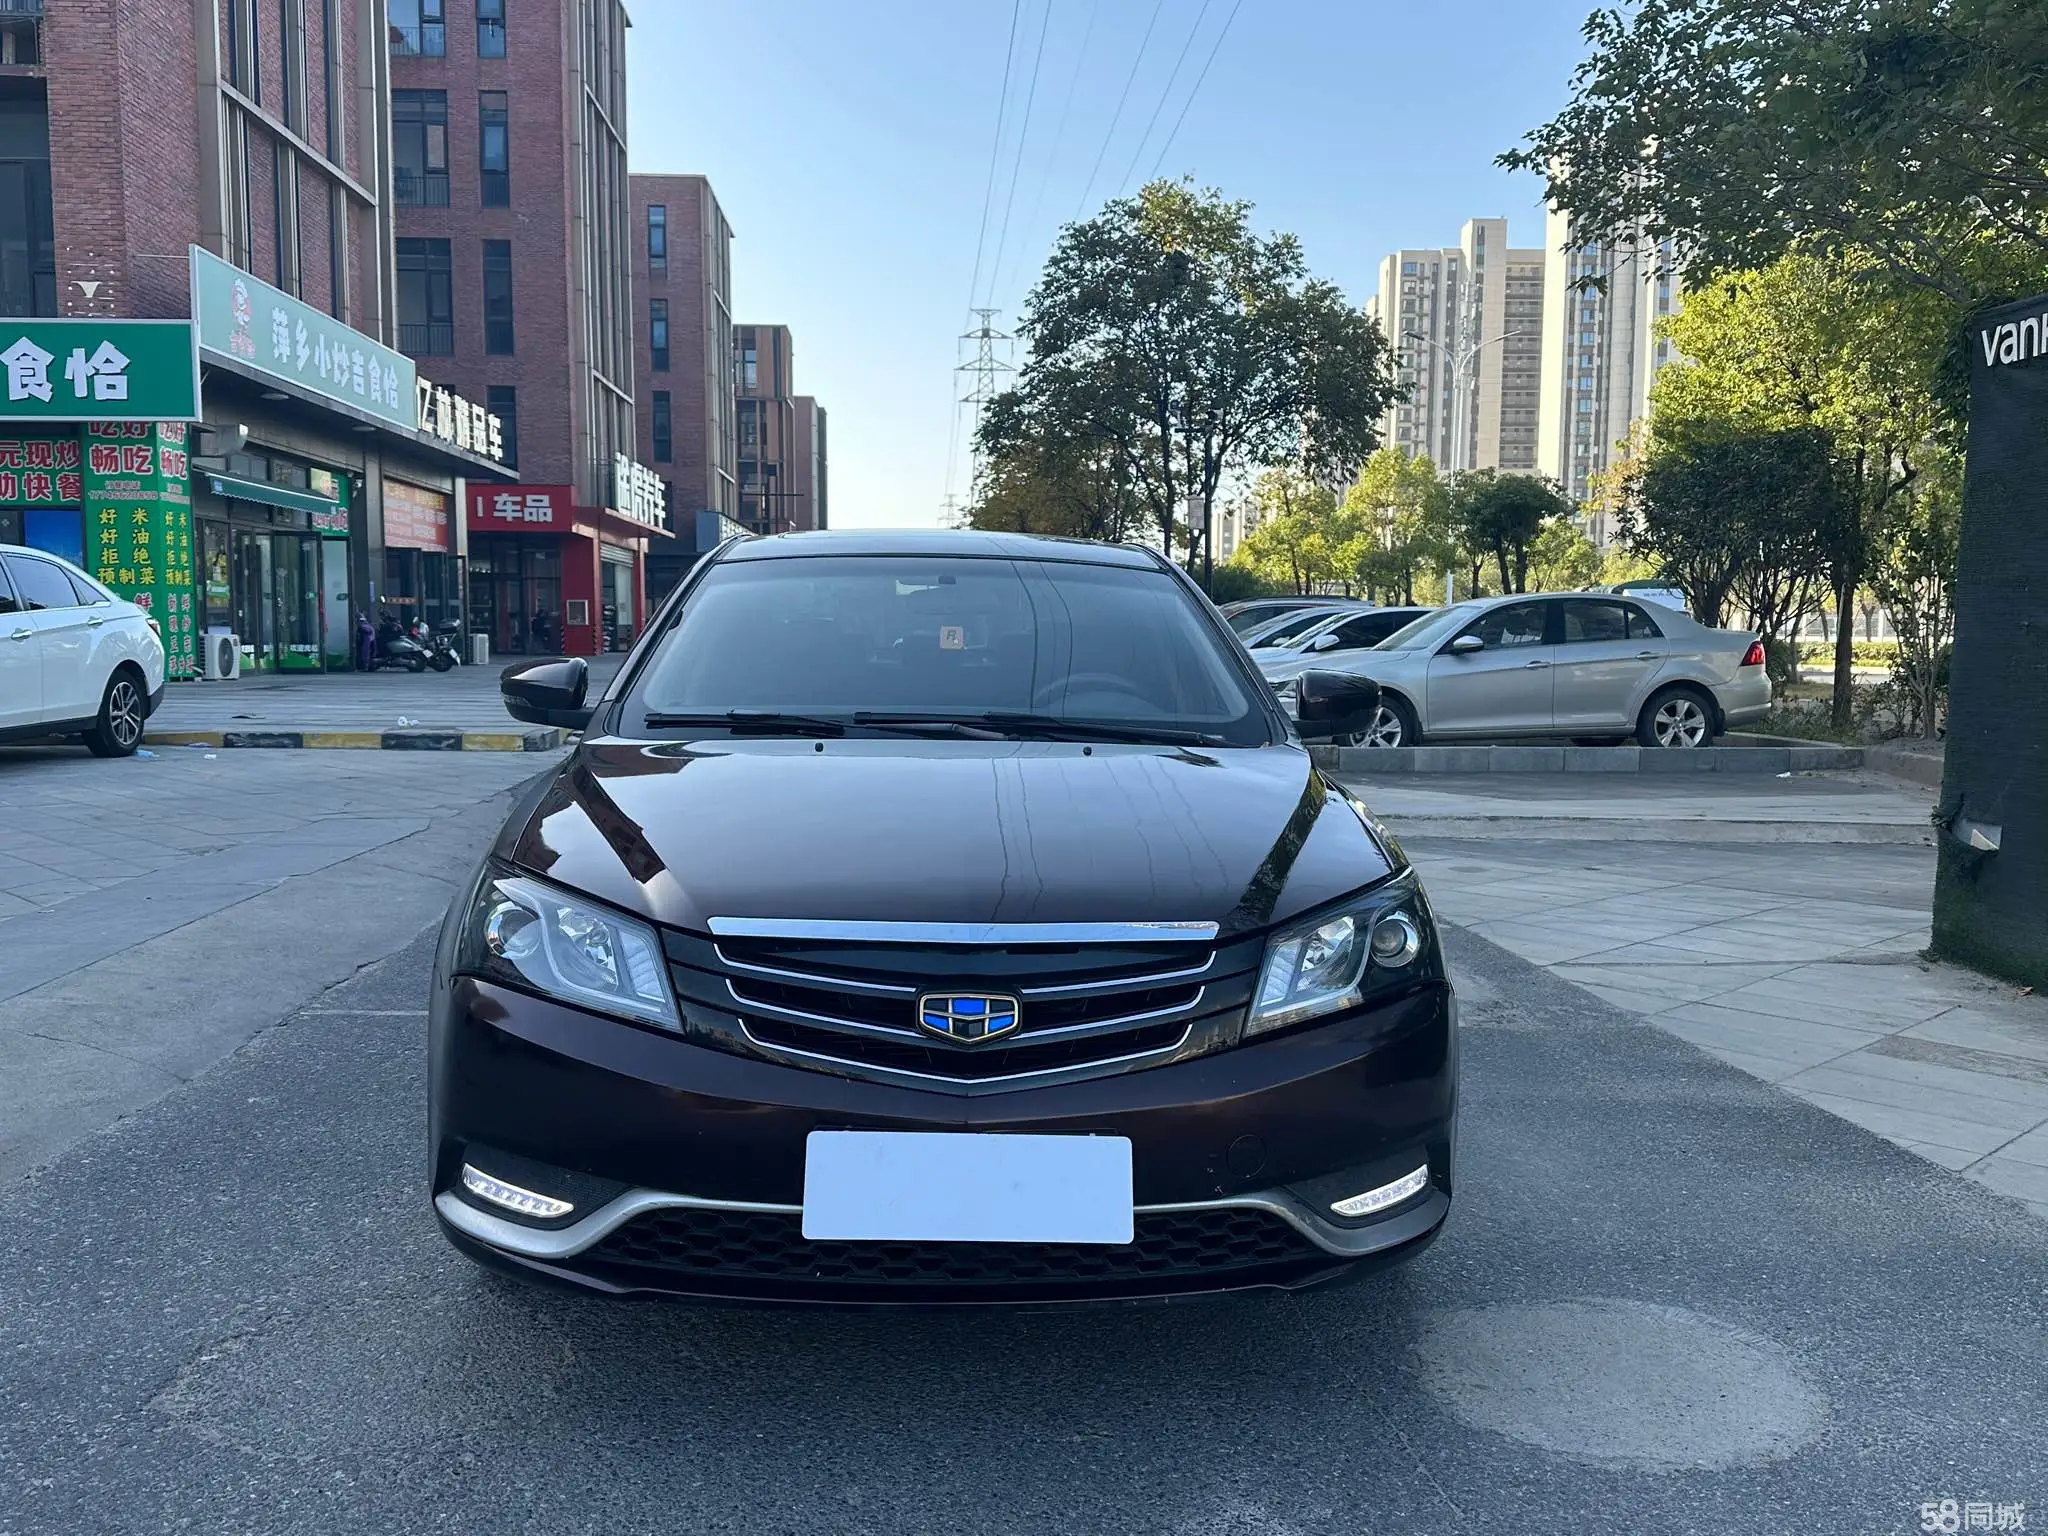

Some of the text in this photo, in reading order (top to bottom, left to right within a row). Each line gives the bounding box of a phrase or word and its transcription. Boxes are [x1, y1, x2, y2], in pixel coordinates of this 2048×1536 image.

[0, 336, 131, 403] 食恰
[272, 306, 399, 409] 萍乡小炒吉食恰
[90, 444, 153, 475] 畅吃
[160, 446, 188, 481] 畅吃
